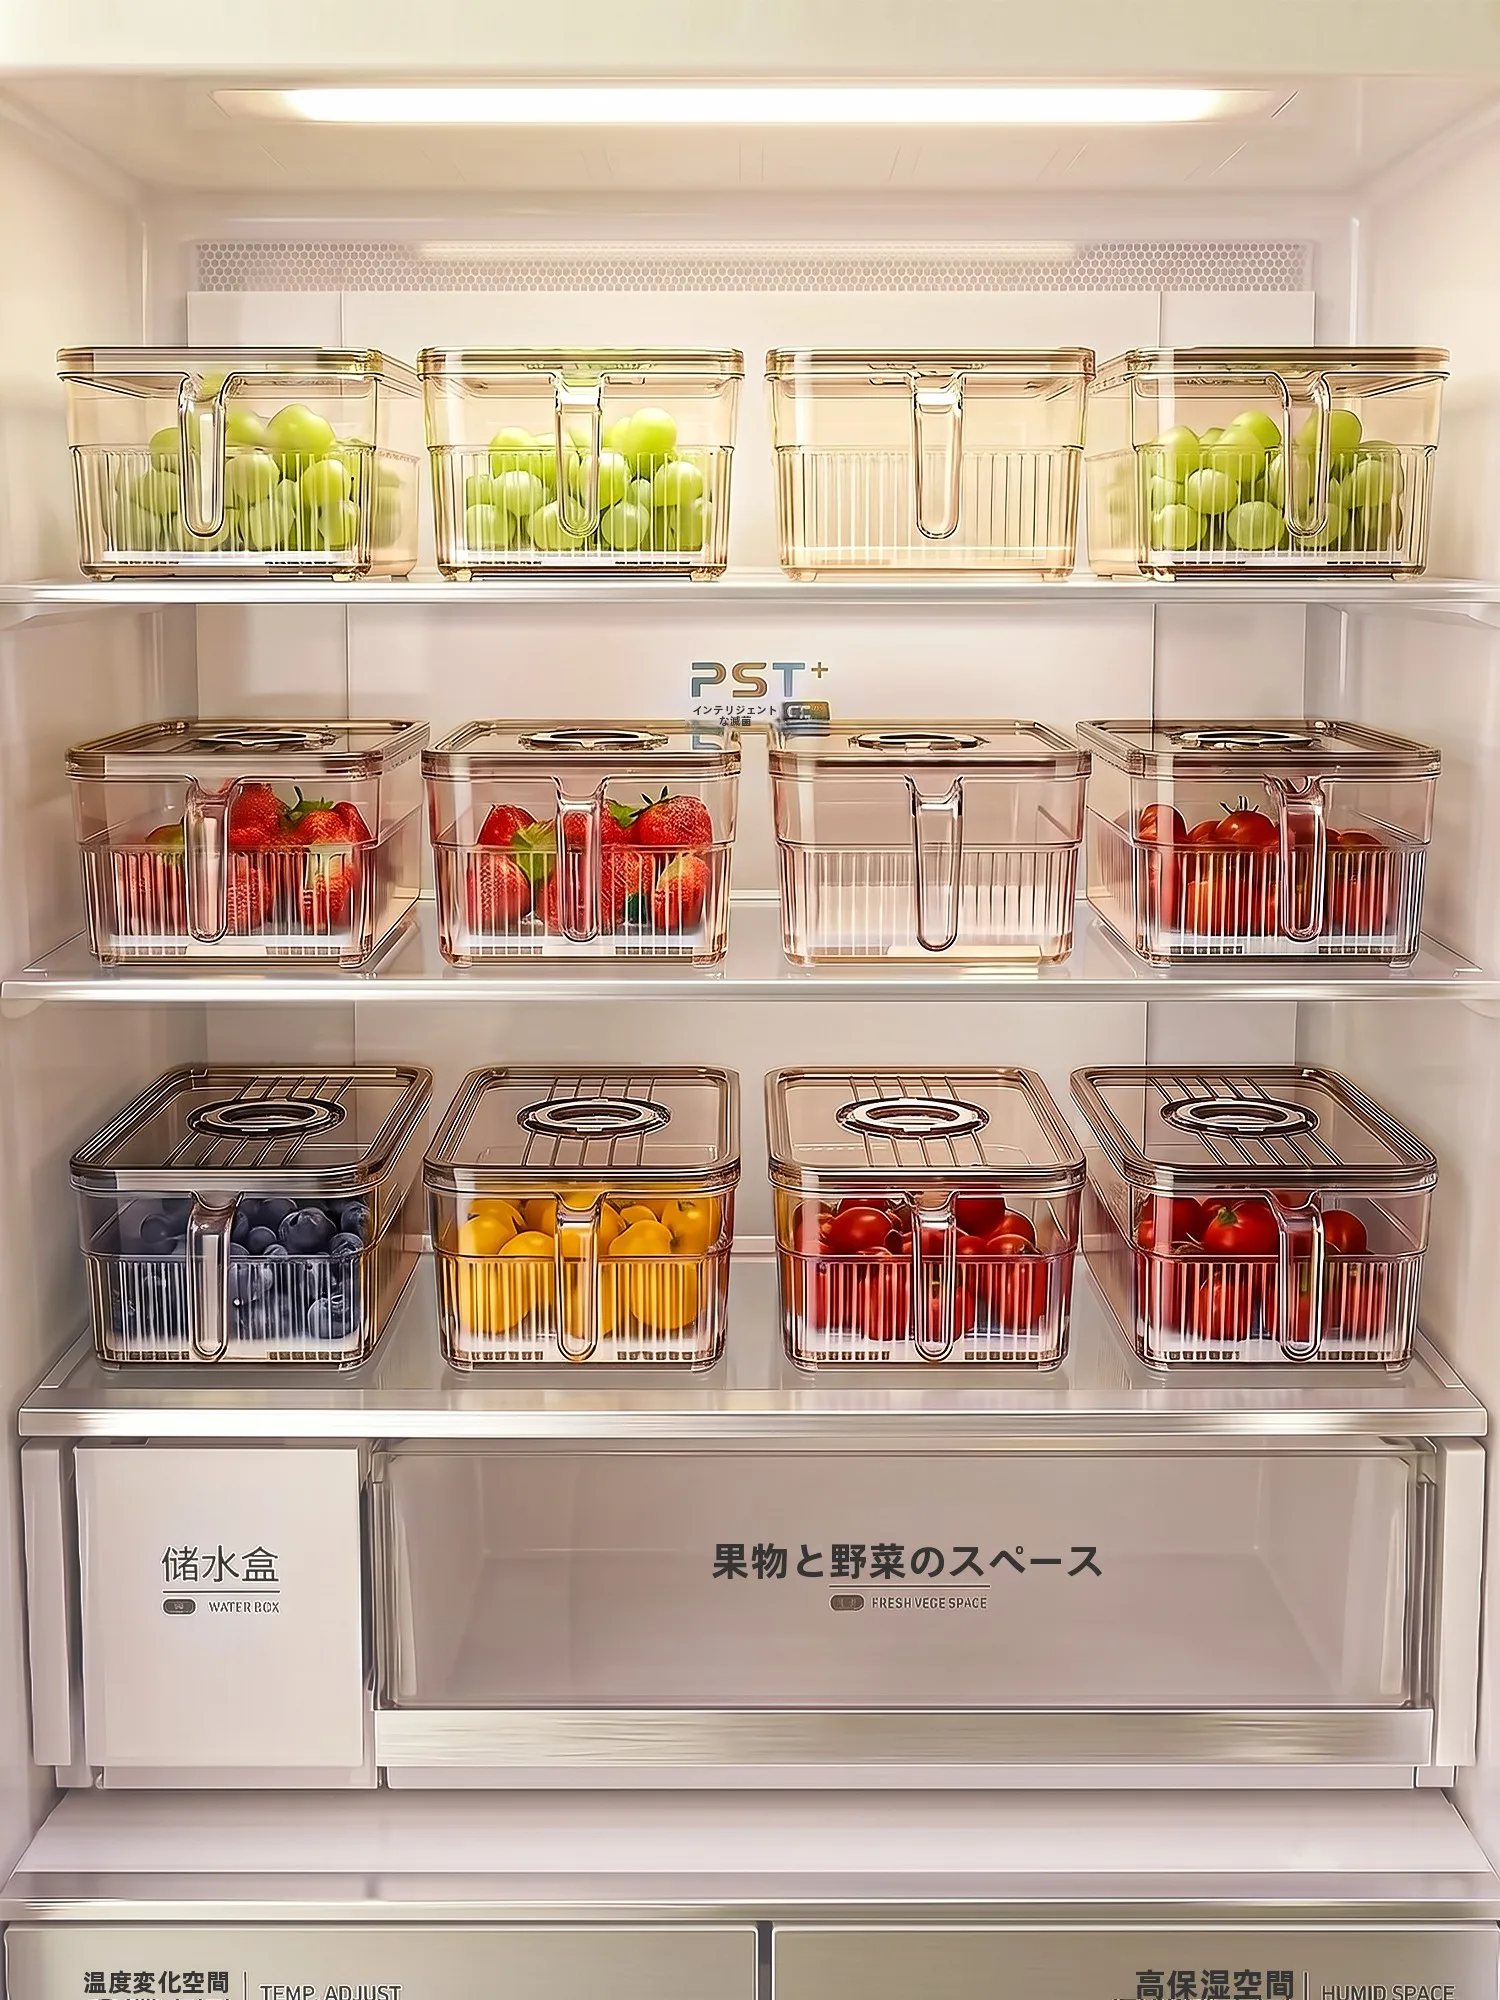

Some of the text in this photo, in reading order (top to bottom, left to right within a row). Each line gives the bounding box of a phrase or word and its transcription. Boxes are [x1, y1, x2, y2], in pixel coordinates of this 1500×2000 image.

[693, 705, 777, 716] インテリジェント
[719, 715, 752, 727] な滅菌
[161, 1544, 280, 1583] 储水盒
[711, 1543, 1103, 1580] 果物と野菜のスペース
[208, 1601, 251, 1613] WATER
[254, 1601, 280, 1613] BOX
[872, 1597, 912, 1609] FRESH
[914, 1597, 946, 1609] VEGE
[948, 1597, 987, 1609] SPACE
[83, 1970, 230, 1995] 温度変化空間
[1135, 1969, 1294, 2000] 高保湿空間
[324, 1985, 402, 2000] ADJUST
[1321, 1985, 1456, 2000] HUMID SPACE
